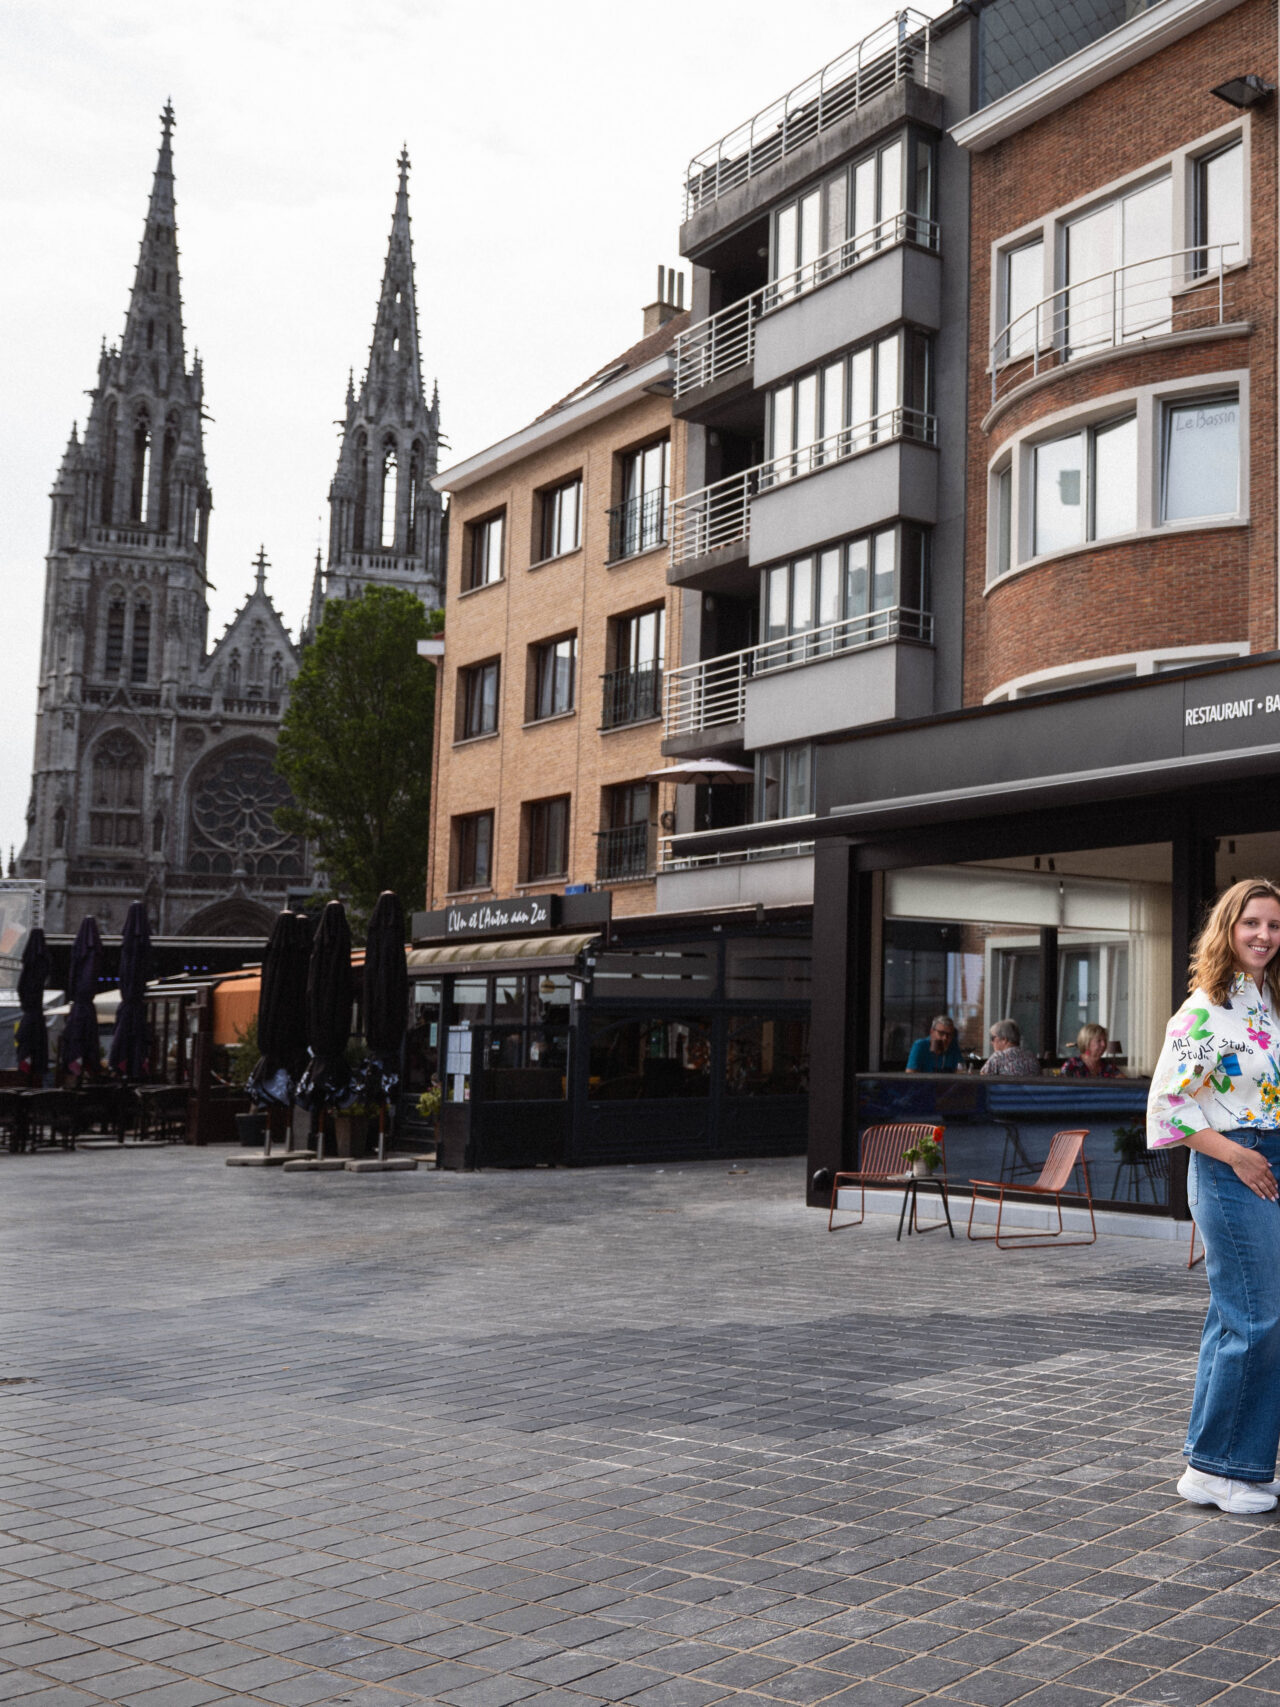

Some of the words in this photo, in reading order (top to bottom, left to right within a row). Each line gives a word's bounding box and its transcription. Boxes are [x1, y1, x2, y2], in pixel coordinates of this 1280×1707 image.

[1176, 413, 1193, 431] Le
[1196, 408, 1235, 430] Bassin
[1185, 697, 1255, 727] RESTAURANT
[468, 913, 478, 931] et
[478, 905, 509, 930] L'Autre
[510, 910, 529, 925] aan
[530, 902, 547, 925] Zee
[1172, 1035, 1190, 1052] ART
[1219, 1037, 1254, 1055] Studio
